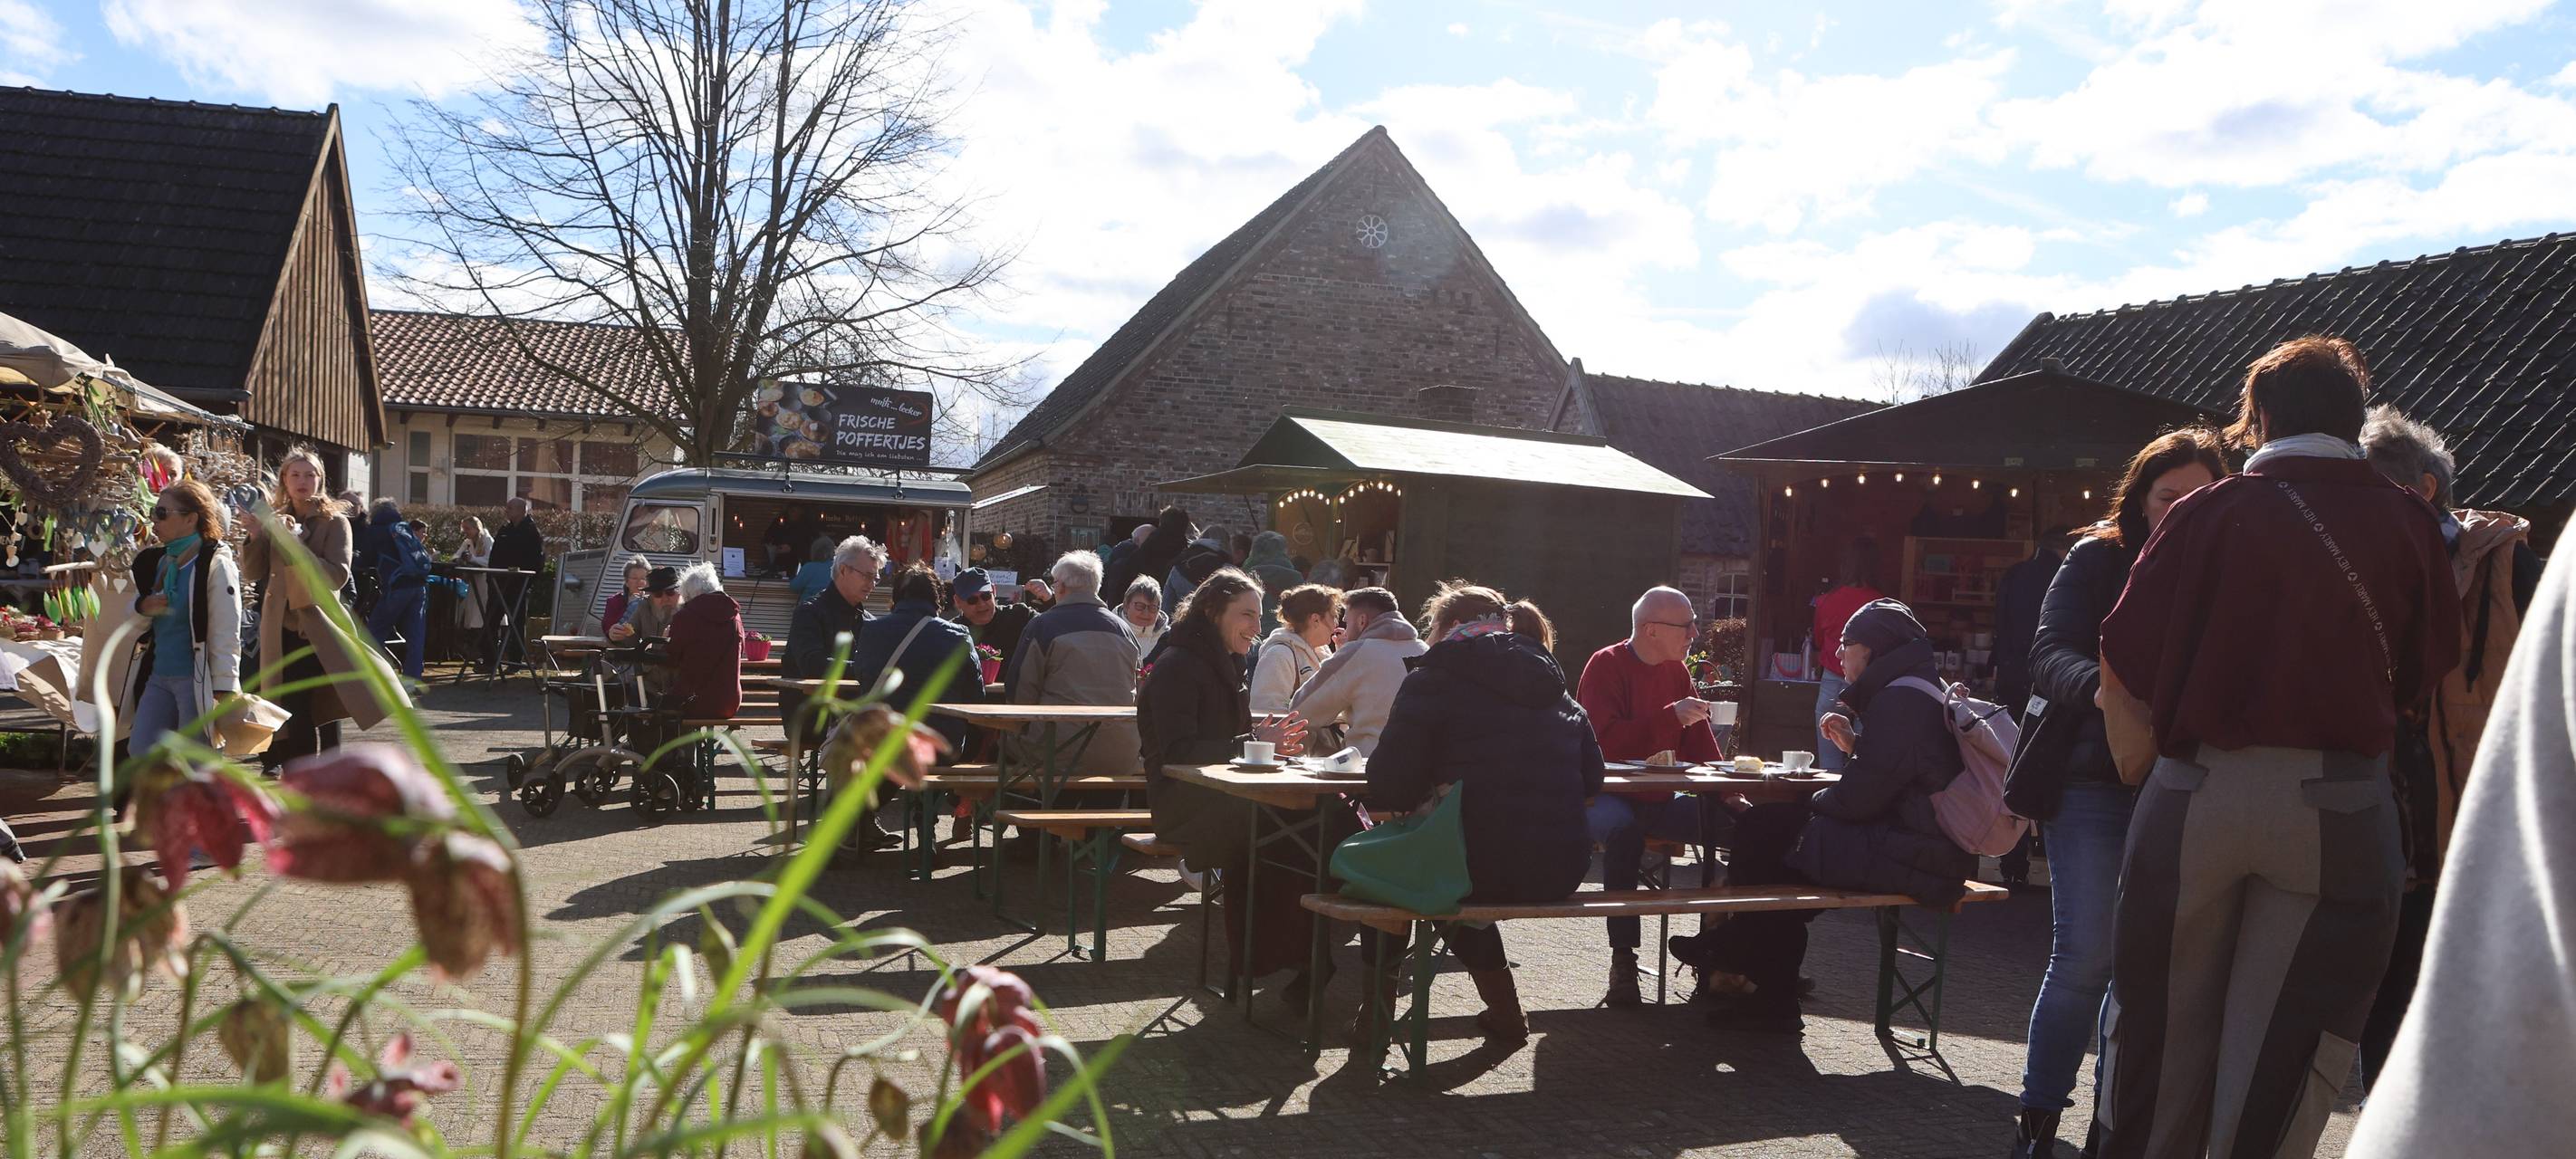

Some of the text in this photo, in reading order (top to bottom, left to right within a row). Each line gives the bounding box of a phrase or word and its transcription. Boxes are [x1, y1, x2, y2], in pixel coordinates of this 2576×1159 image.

[839, 414, 896, 429] FRISCHE
[836, 430, 926, 450] POFFERTJES
[2302, 507, 2318, 523] HEY
